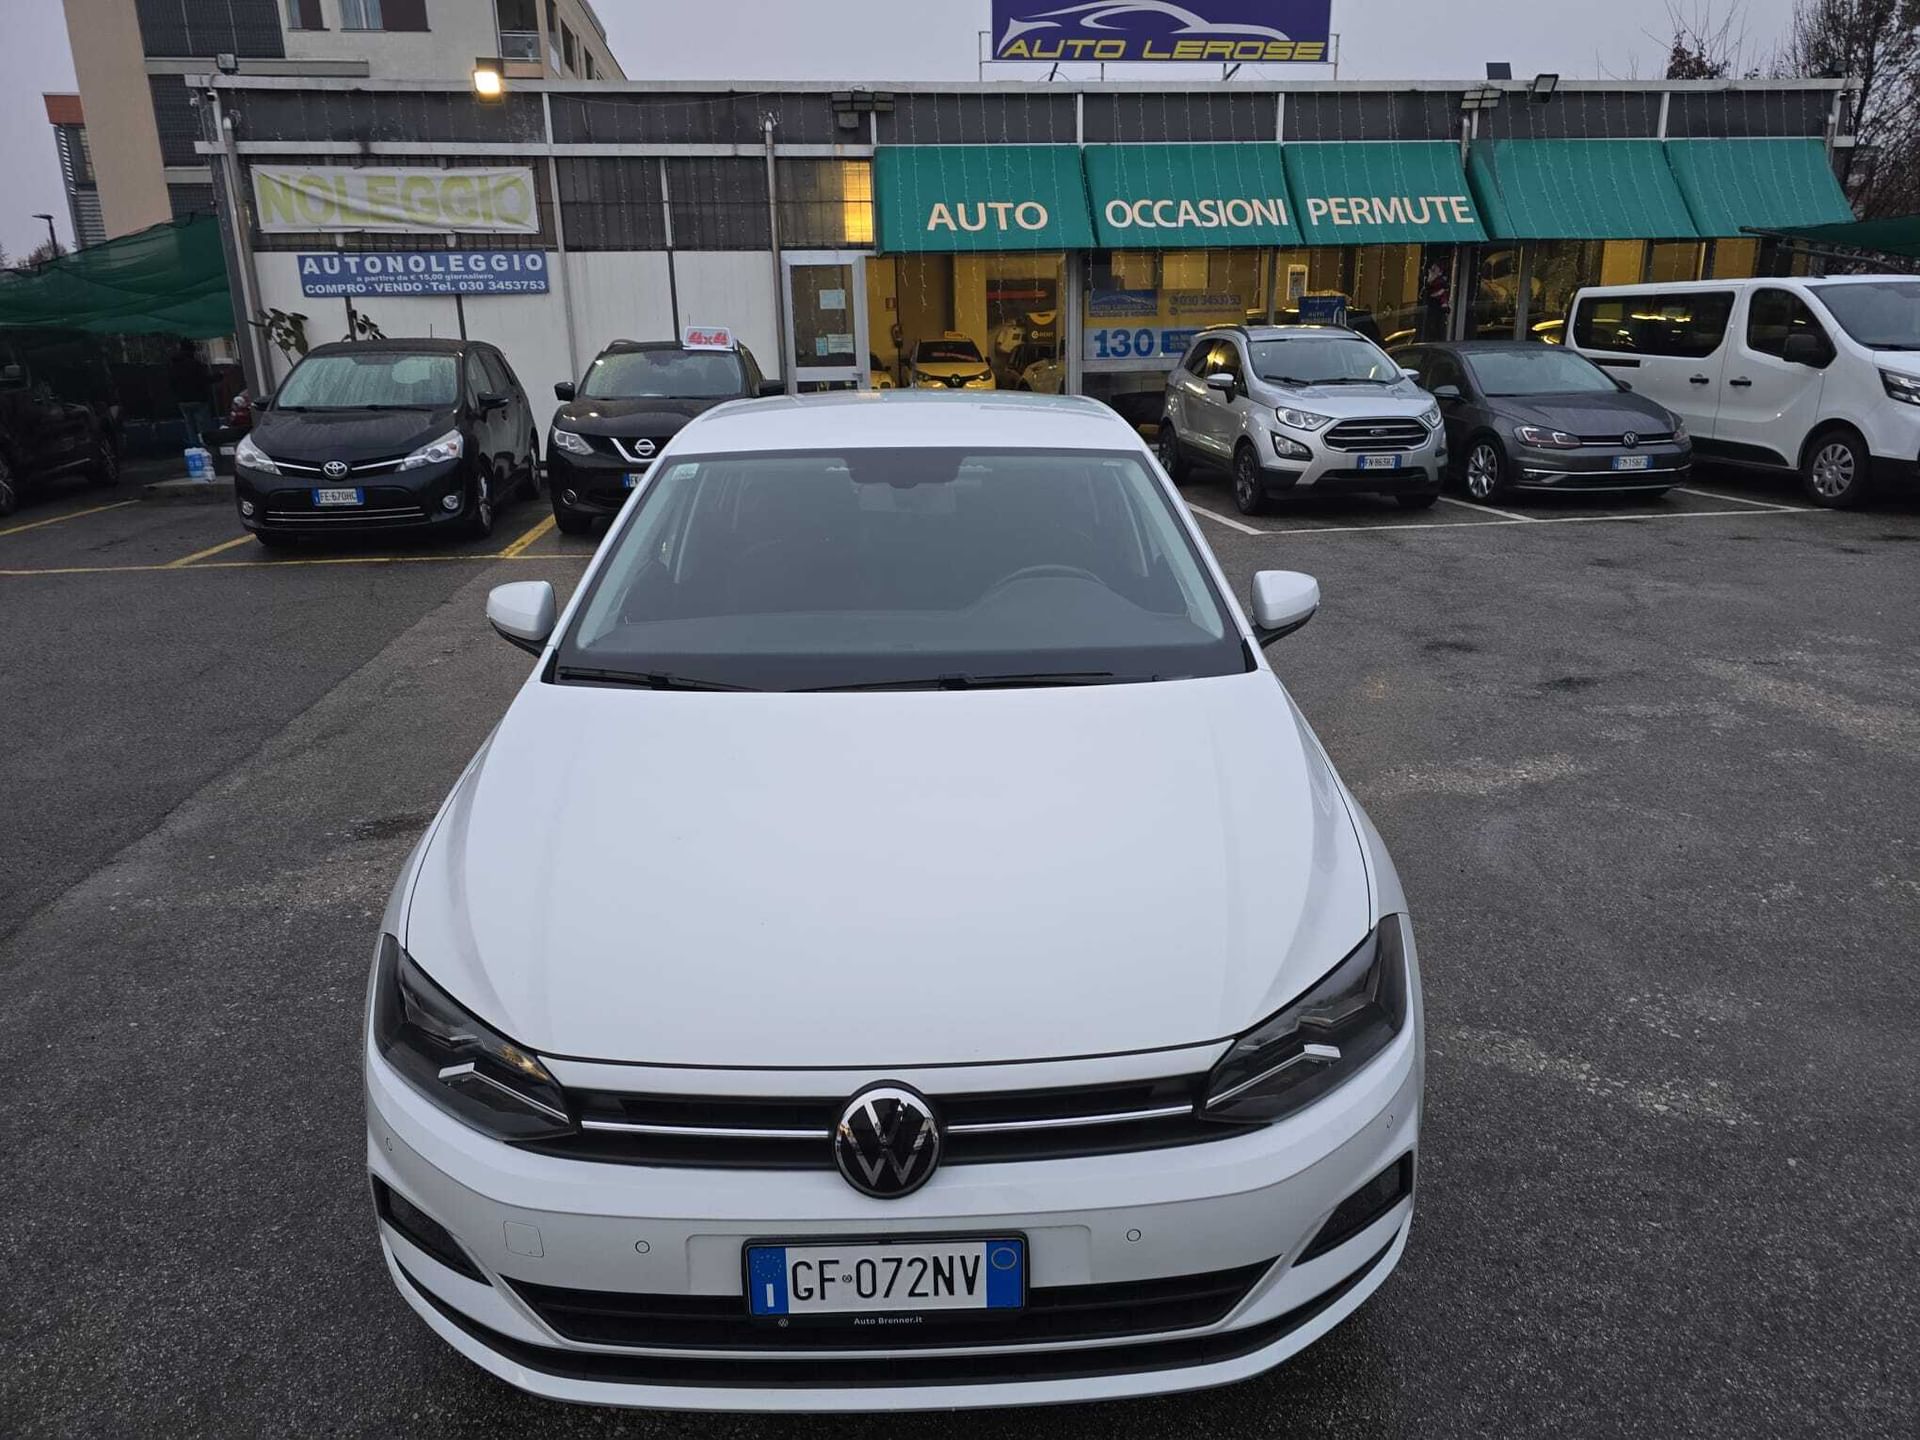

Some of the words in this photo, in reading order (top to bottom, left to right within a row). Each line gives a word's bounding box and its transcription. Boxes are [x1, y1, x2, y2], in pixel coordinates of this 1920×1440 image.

[1002, 39, 1128, 59] AUTO
[1142, 40, 1326, 61] LEROSE
[256, 173, 533, 226] NOLEGGIO
[1306, 195, 1475, 227] PERMUTE
[927, 201, 1049, 232] AUTO
[1105, 198, 1289, 229] OCCASIONI
[303, 254, 543, 275] AUTONOLEGGIO
[305, 283, 367, 294] COMPRO
[374, 281, 423, 293] VENDO
[430, 282, 456, 291] Tel.
[459, 281, 485, 291] 030
[488, 280, 546, 291] 3453753
[364, 274, 395, 284] partire
[396, 273, 408, 281] da
[445, 272, 494, 282] giornaliero
[687, 331, 729, 345] 4x4
[1094, 328, 1155, 358] 130
[791, 1259, 840, 1301] GF
[855, 1254, 981, 1300] 072NV
[854, 1317, 876, 1326] Auto
[878, 1316, 923, 1326] Brenner.it
